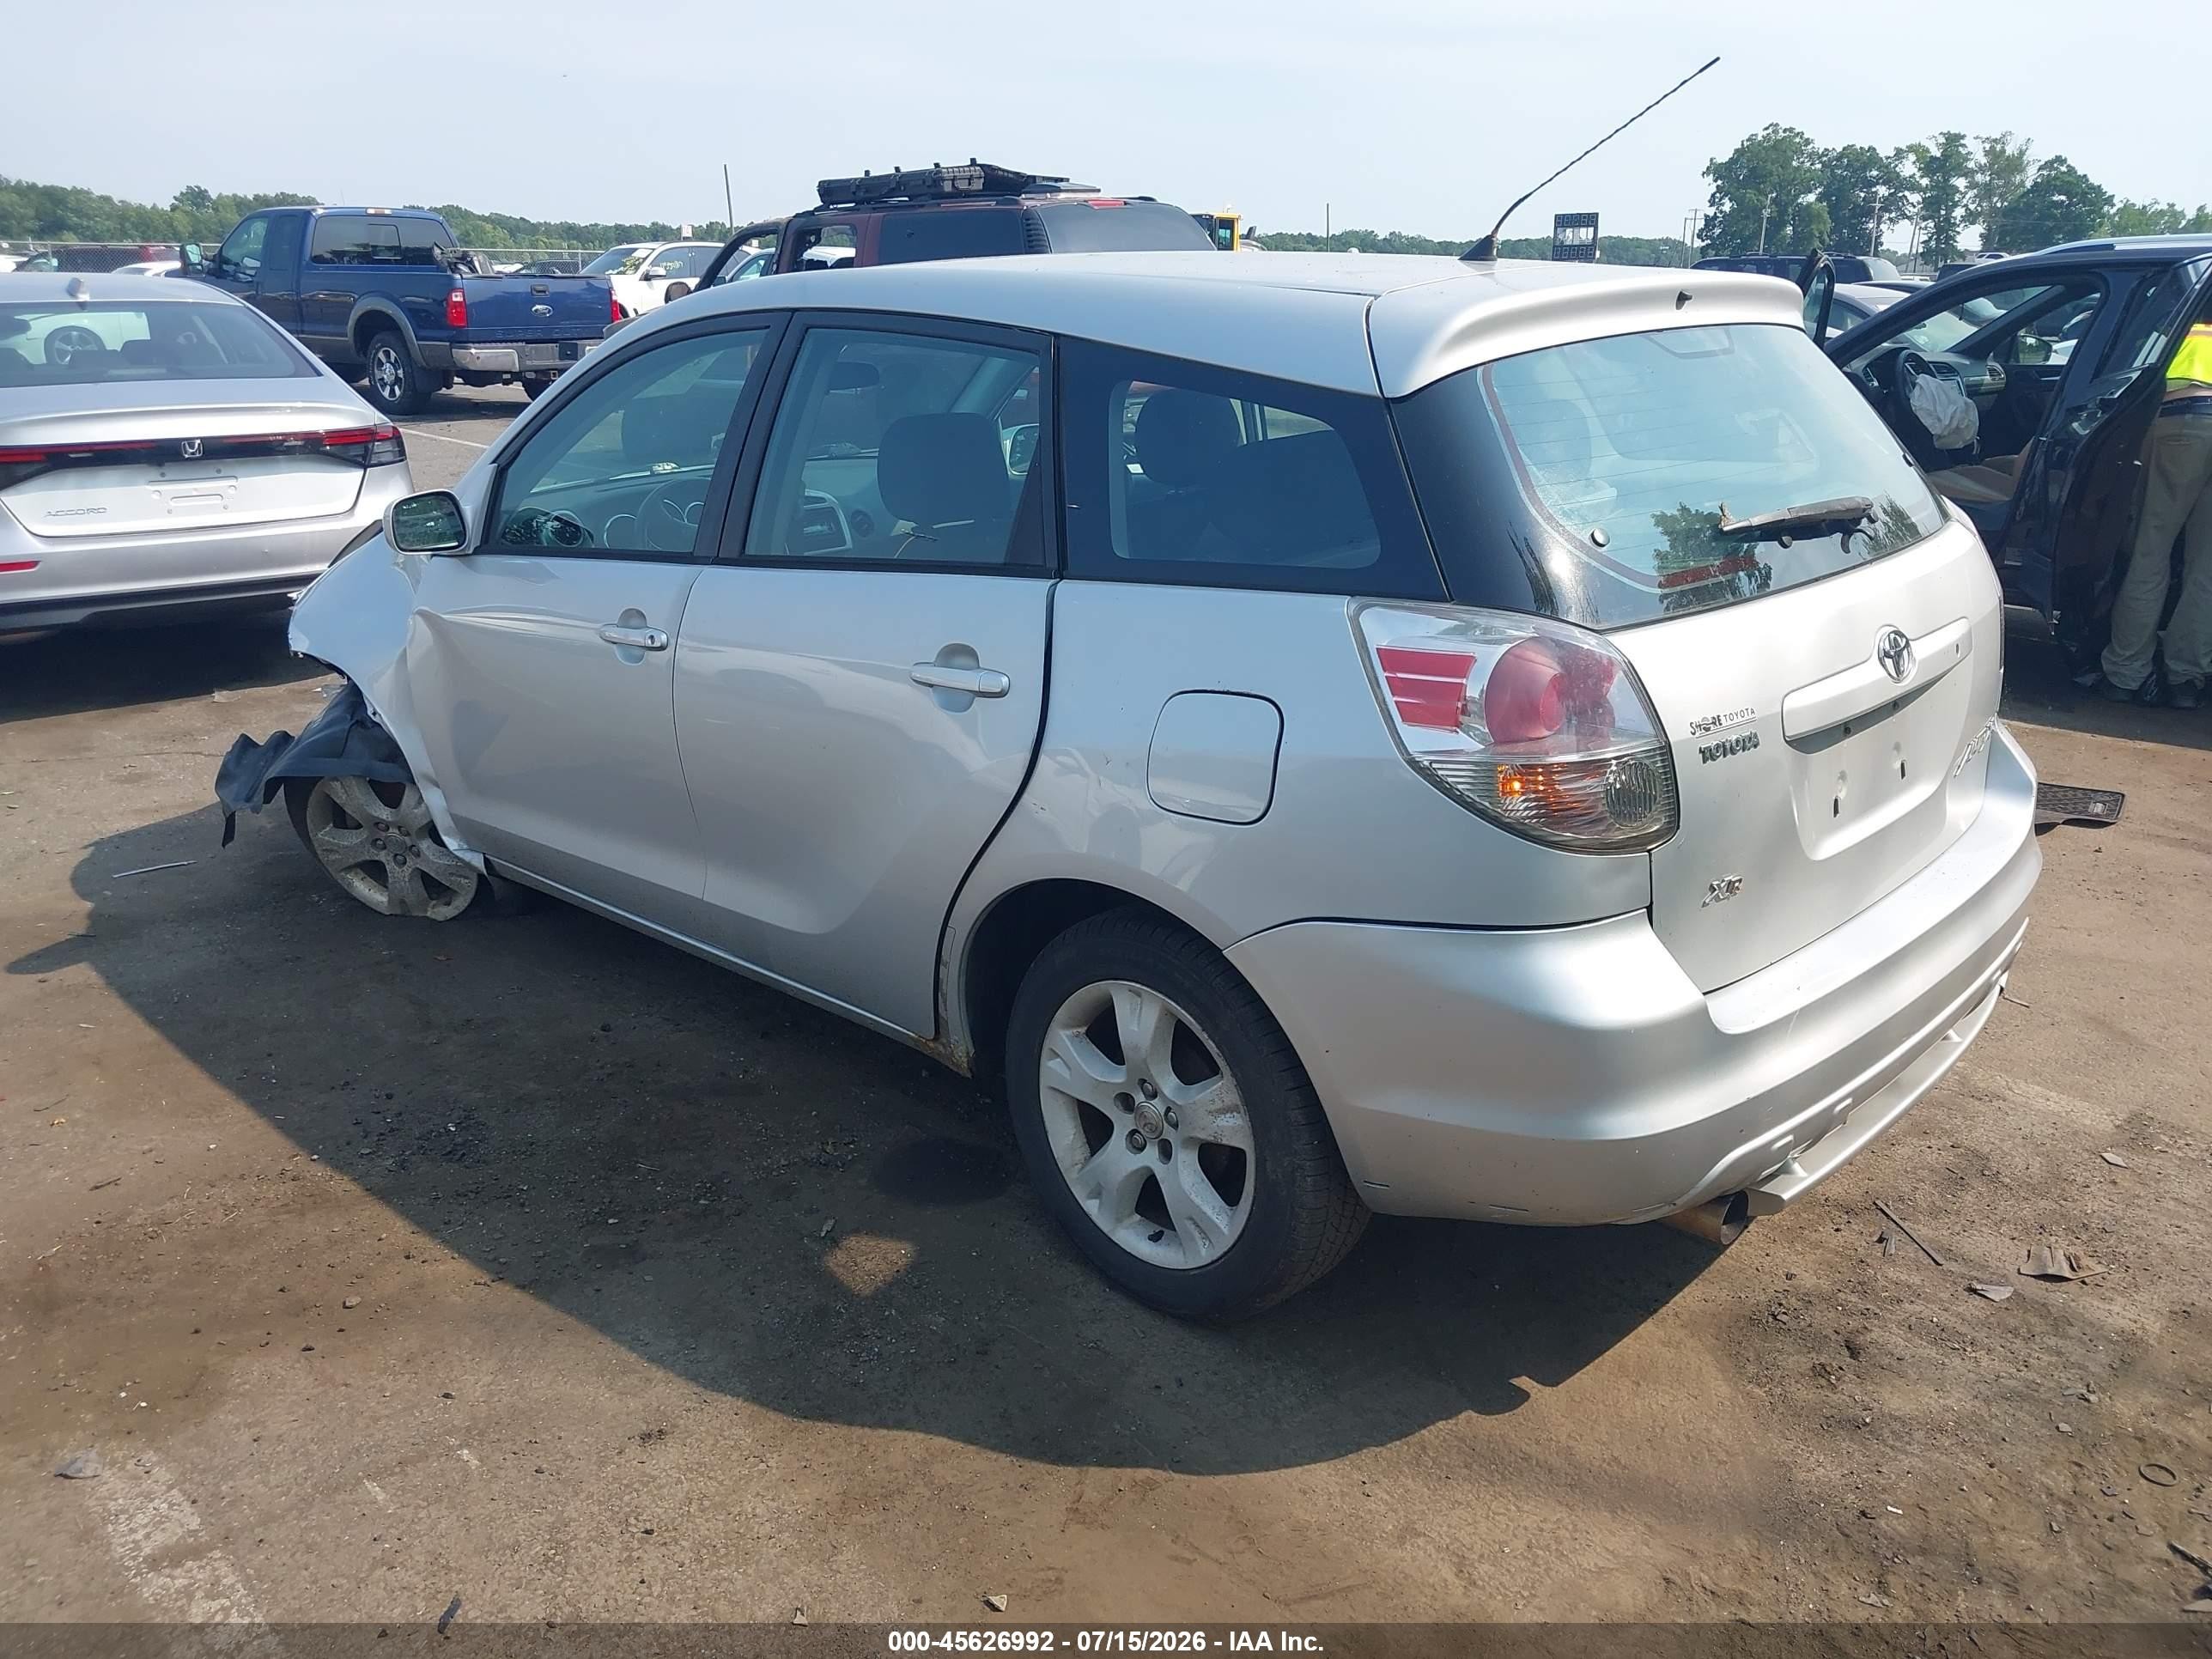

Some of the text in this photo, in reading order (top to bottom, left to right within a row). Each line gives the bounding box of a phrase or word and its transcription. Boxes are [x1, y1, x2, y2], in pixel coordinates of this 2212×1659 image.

[45, 507, 107, 517] ACCORD
[1723, 707, 1756, 723] TOYOTA
[1698, 730, 1760, 765] TOYOTA
